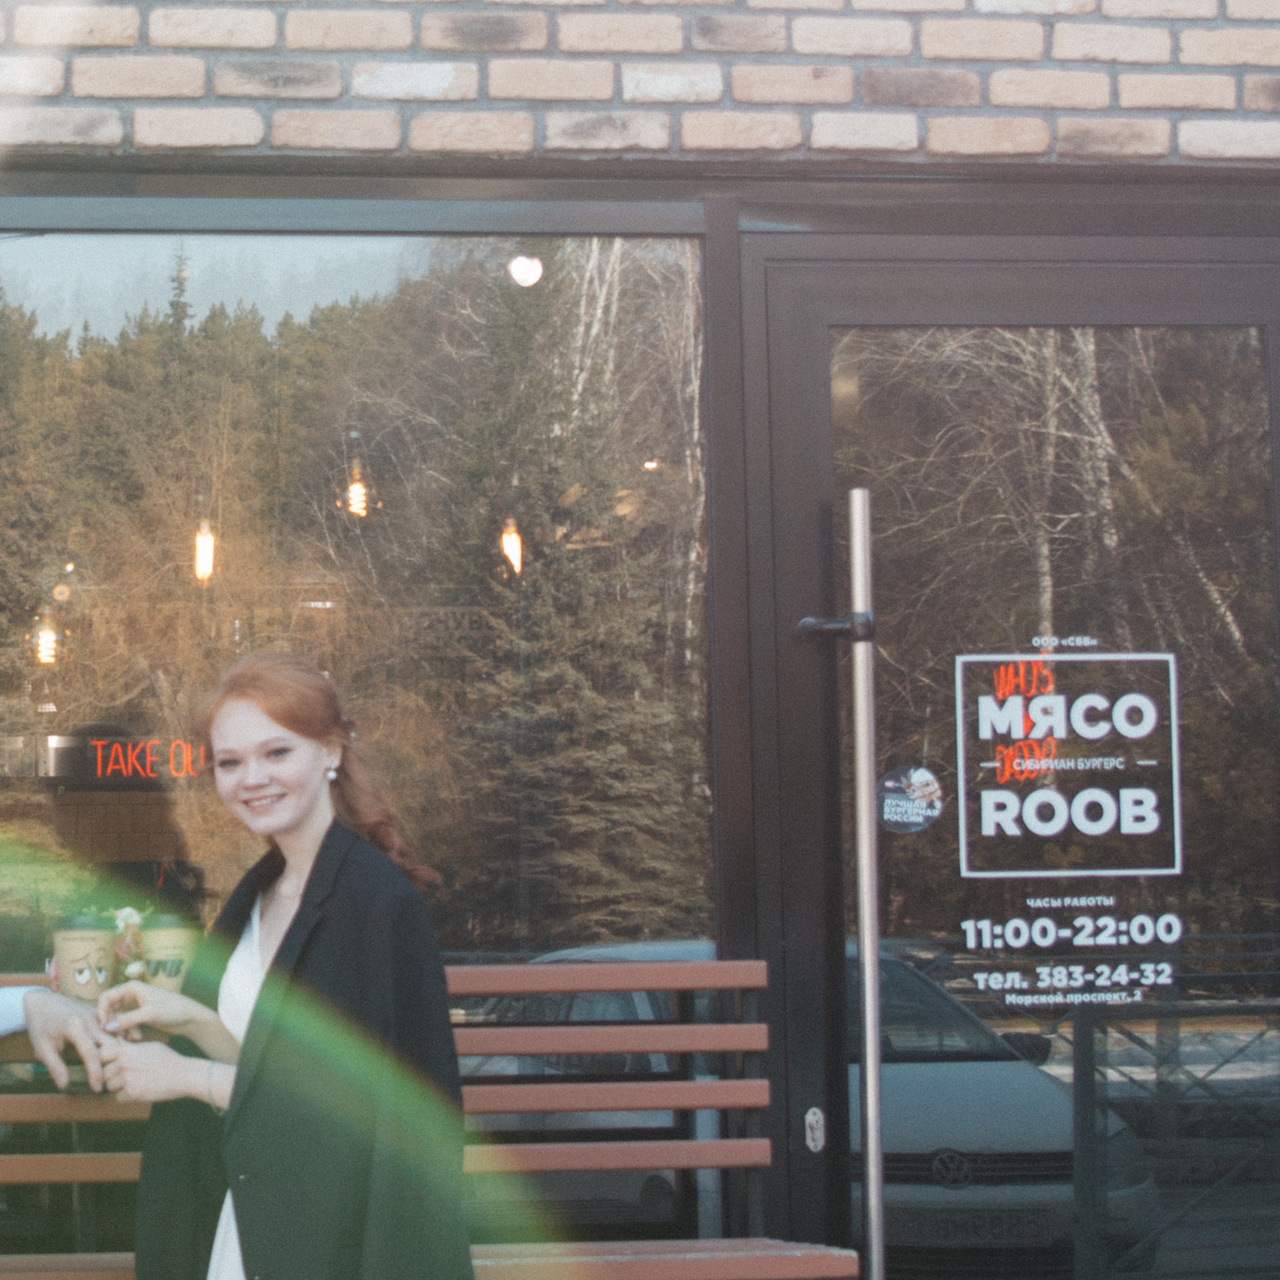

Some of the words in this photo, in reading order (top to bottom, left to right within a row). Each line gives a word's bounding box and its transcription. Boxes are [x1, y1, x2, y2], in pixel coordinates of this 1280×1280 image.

[978, 693, 1158, 740] МЯСО
[90, 739, 160, 778] TAKE
[169, 739, 205, 778] OU
[1077, 757, 1125, 770] БУРГЕРС
[980, 787, 1160, 837] ROOB
[1026, 898, 1062, 908] ЧАСЫ
[1064, 896, 1114, 907] РАБОТЫ
[960, 914, 1183, 949] 11:00-22:00
[974, 970, 1029, 990] тел.
[1036, 963, 1172, 988] 383-24-32
[1005, 993, 1064, 1006] Морской
[1066, 991, 1131, 1005] проспект,
[1133, 990, 1142, 1001] 2
